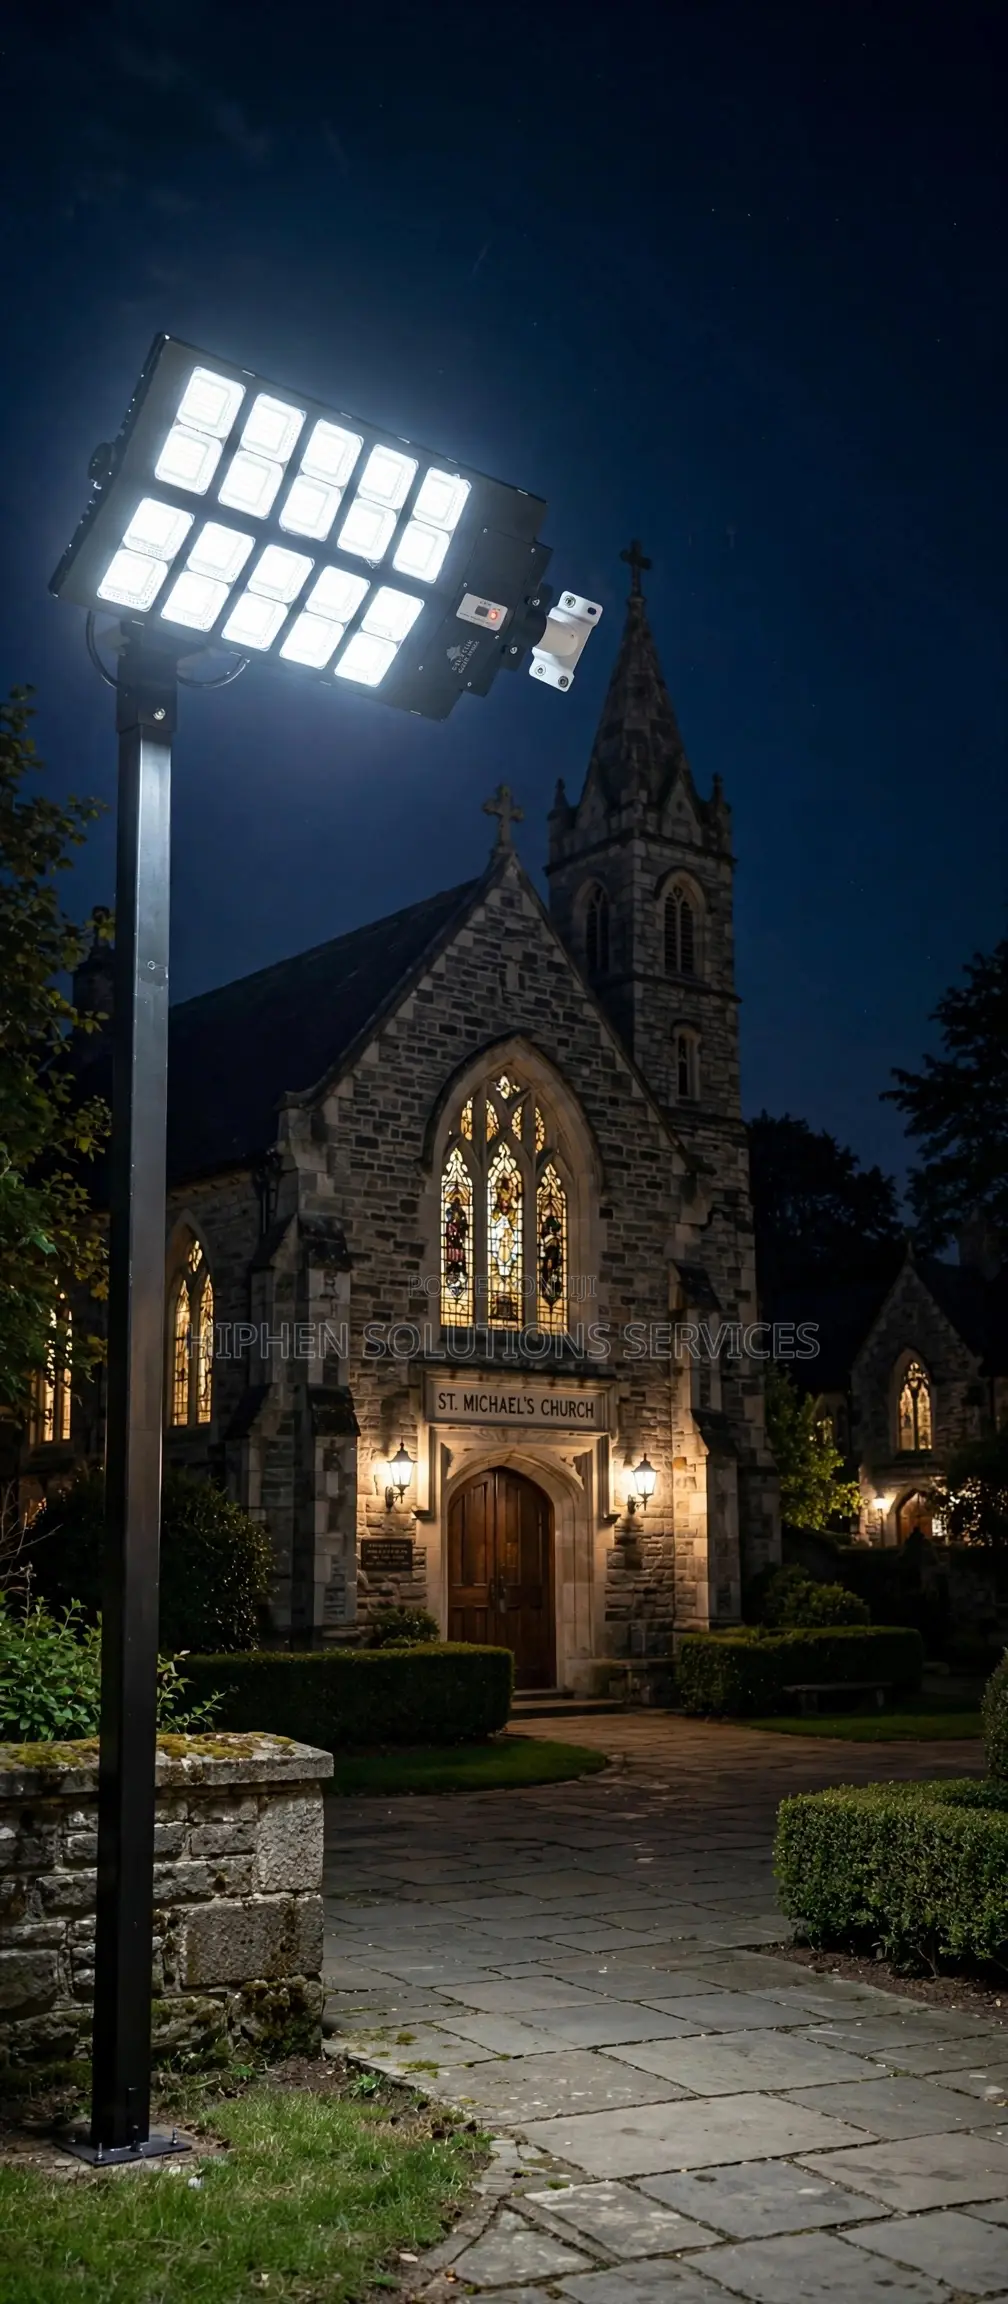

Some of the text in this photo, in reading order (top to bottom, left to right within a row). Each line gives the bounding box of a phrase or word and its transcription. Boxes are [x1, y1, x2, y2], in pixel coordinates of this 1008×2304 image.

[438, 1392, 595, 1419] ST. MICHAEL'S CHURCH
